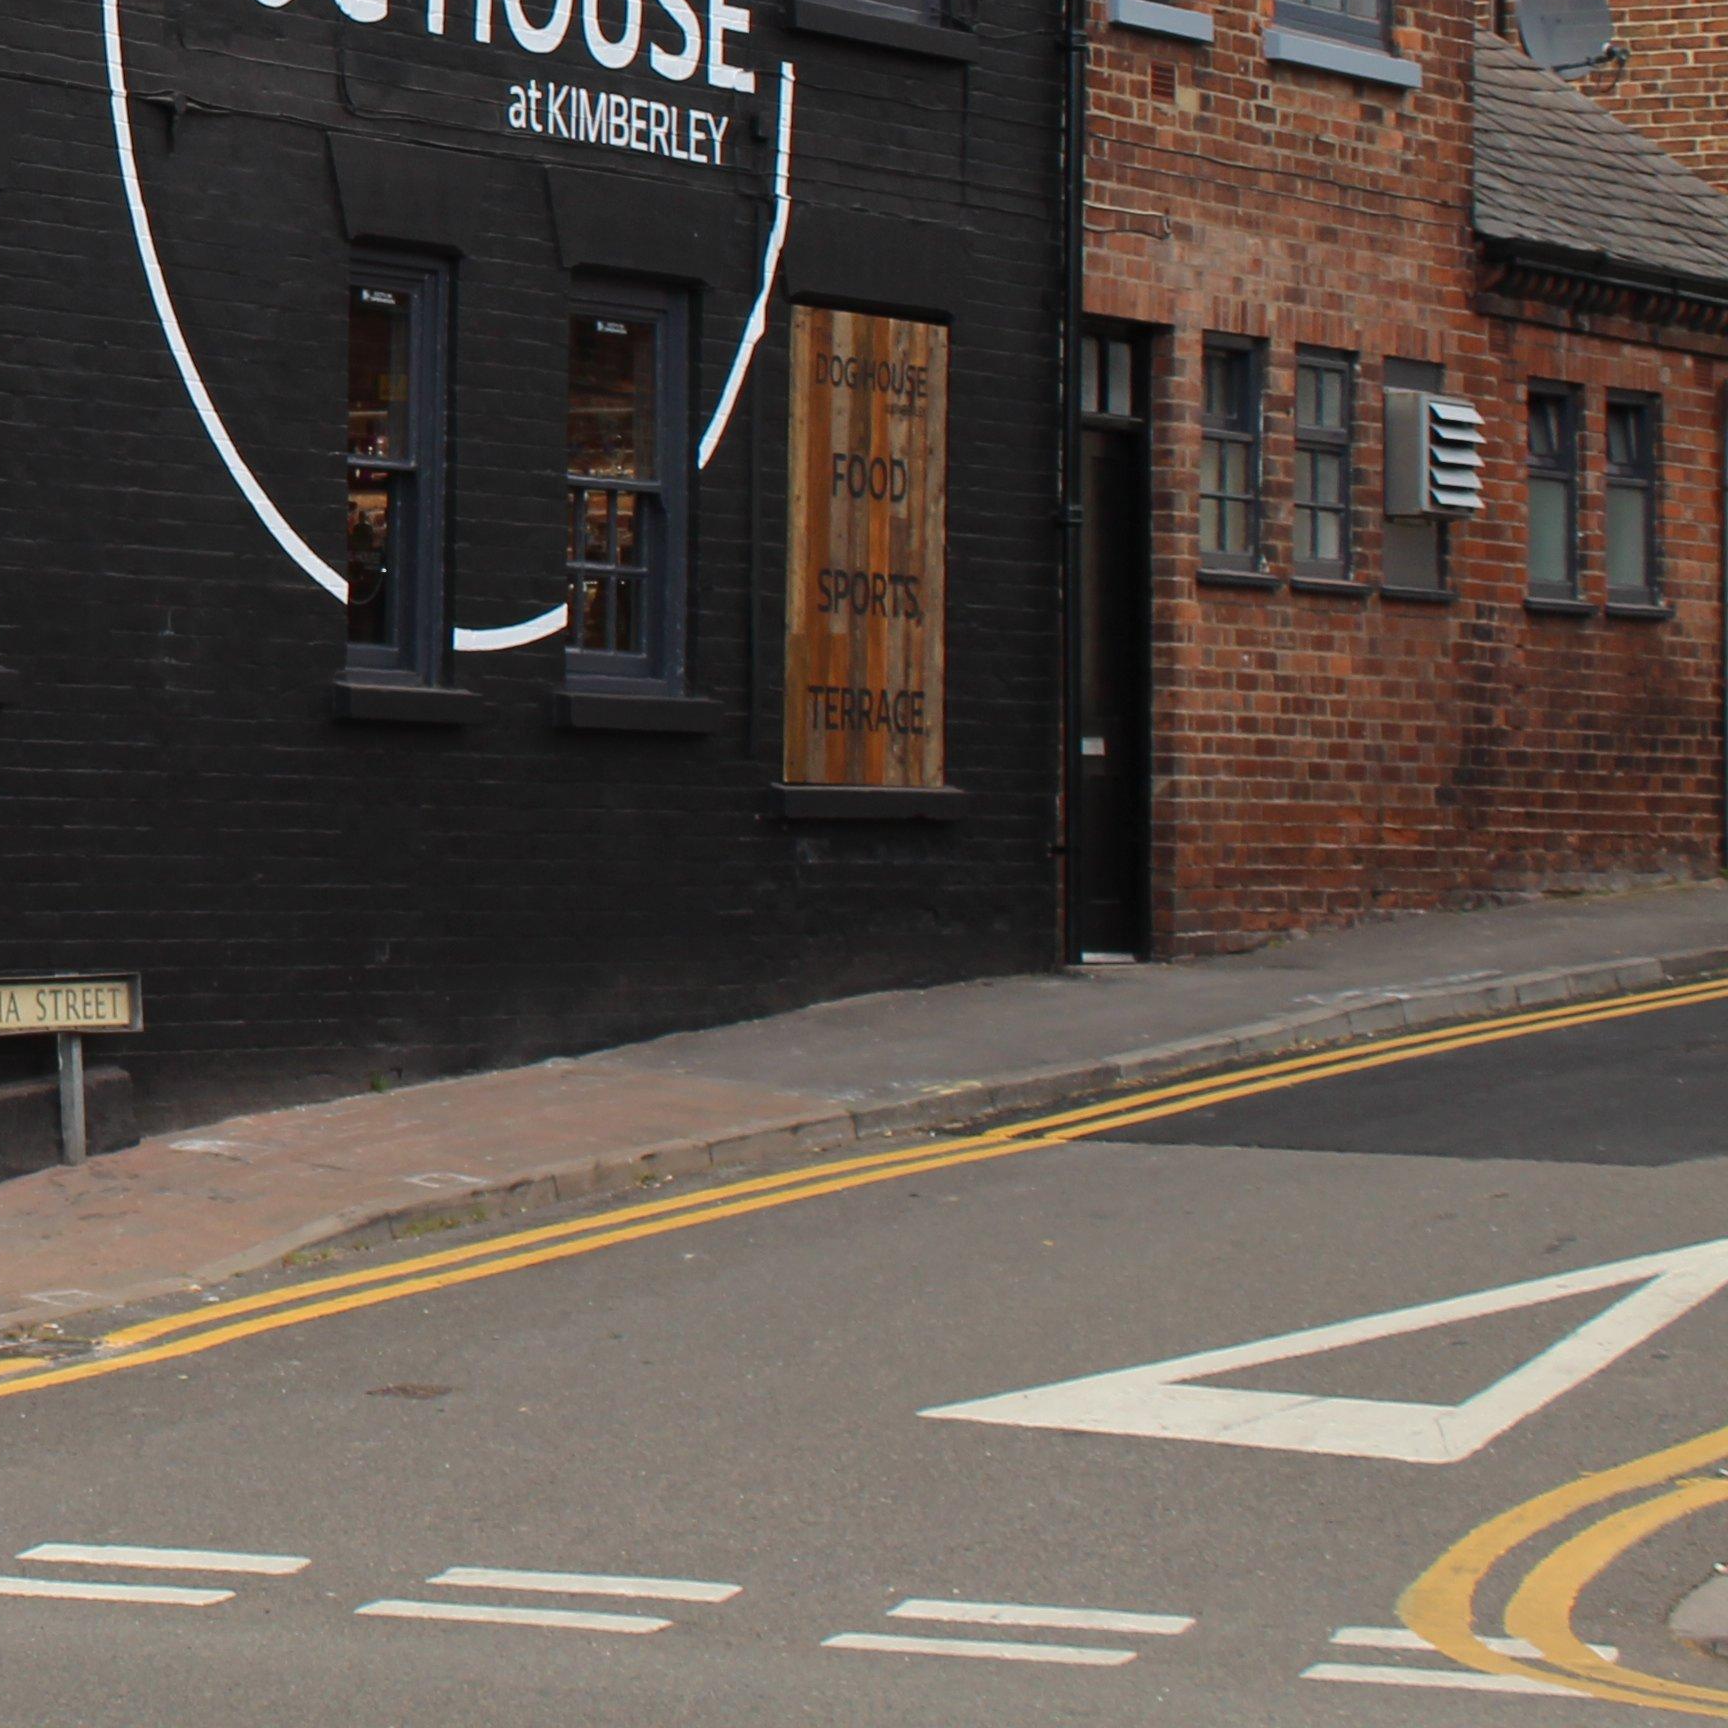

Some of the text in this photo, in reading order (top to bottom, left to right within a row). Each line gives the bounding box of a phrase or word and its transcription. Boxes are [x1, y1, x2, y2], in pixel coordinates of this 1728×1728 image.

[545, 82, 729, 166] KIMBERLEY
[815, 352, 929, 398] DOG HOUSE
[831, 452, 909, 503] FOOD
[807, 684, 925, 736] TERRACE
[35, 987, 122, 1022] STREET
